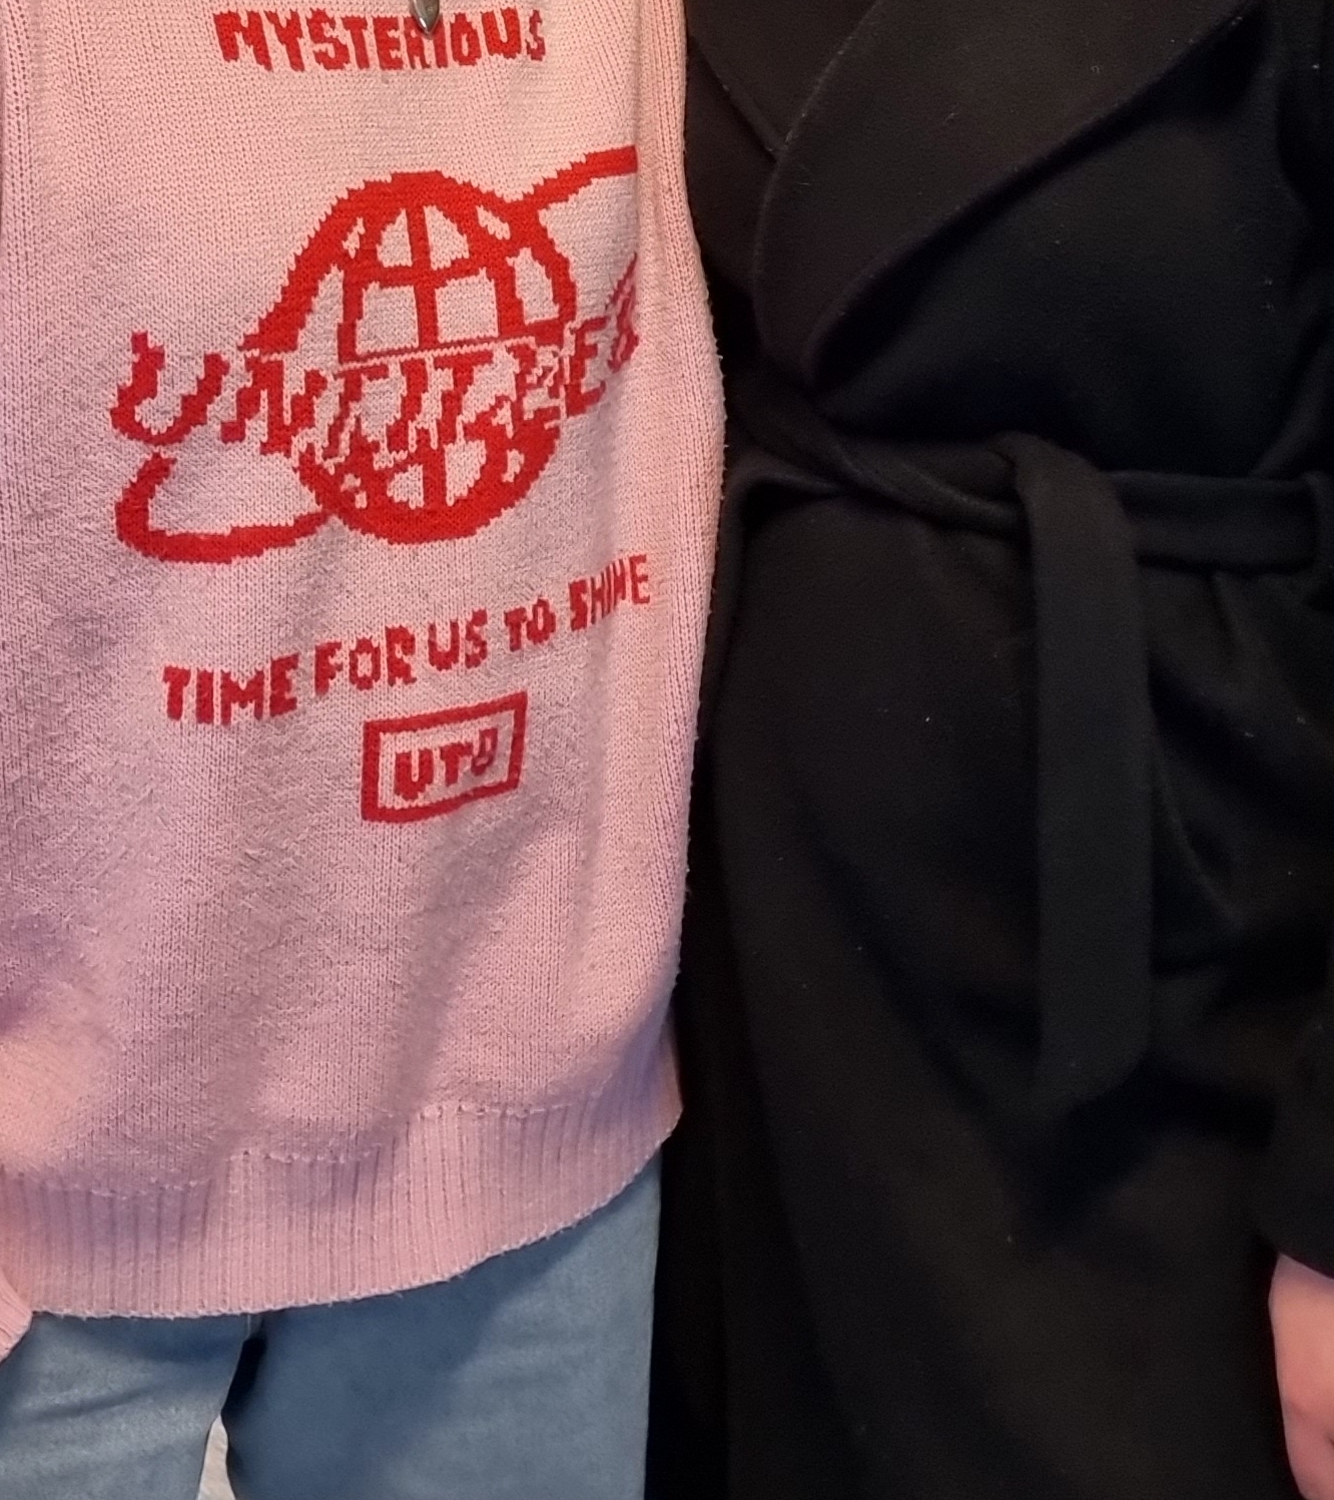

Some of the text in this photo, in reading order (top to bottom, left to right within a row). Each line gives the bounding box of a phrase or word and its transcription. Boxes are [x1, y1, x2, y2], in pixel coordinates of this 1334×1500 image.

[214, 7, 545, 71] MYSTERIOUS
[164, 555, 649, 724] TIME FOR US TO SHINE
